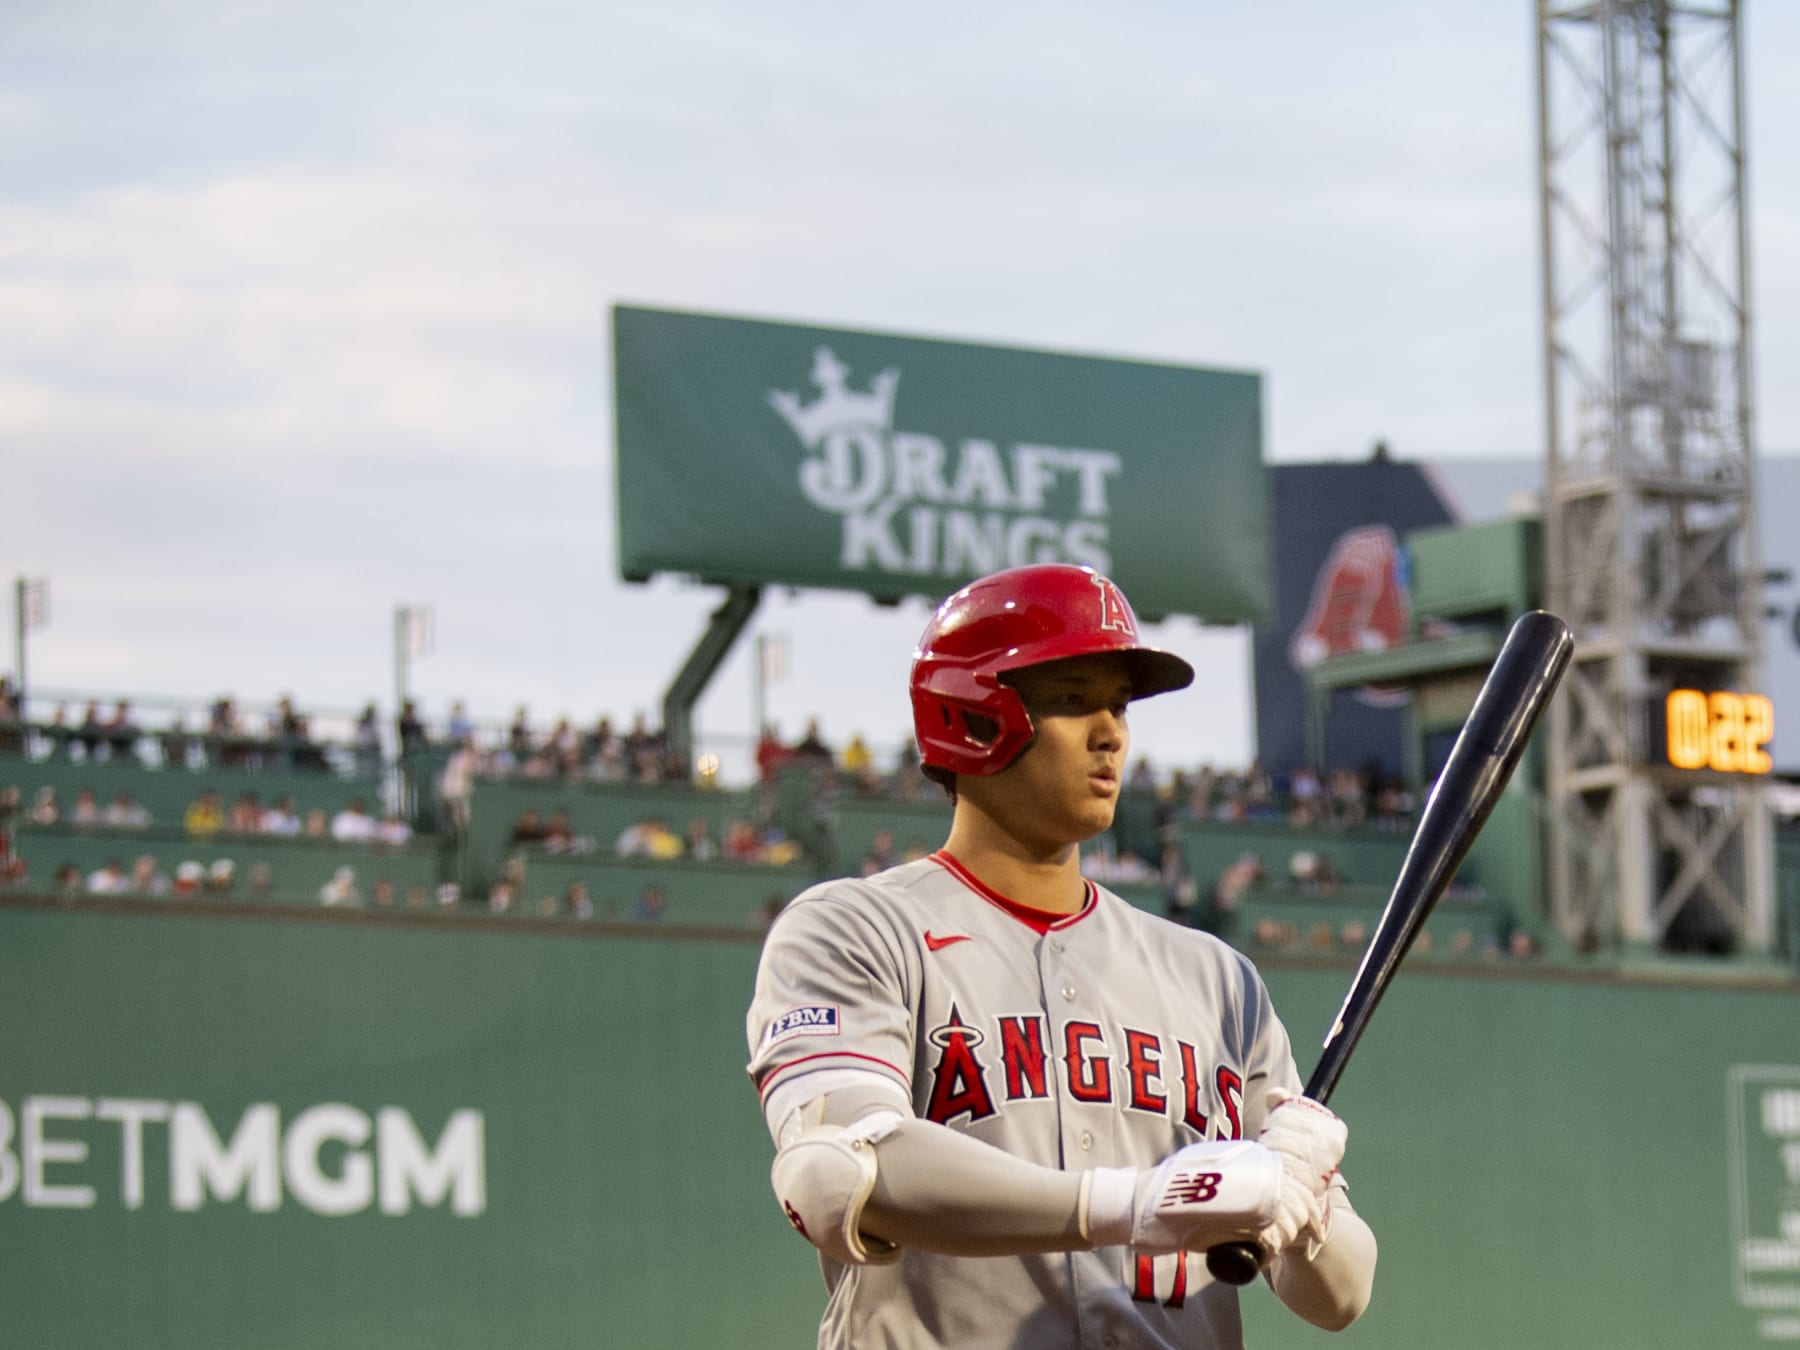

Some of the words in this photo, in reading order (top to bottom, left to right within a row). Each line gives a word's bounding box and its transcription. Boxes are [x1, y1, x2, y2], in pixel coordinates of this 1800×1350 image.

[800, 430, 1121, 515] DRAFT
[840, 503, 1114, 577] KINGS
[775, 1008, 829, 1034] FBM
[925, 997, 1243, 1142] ANGELS
